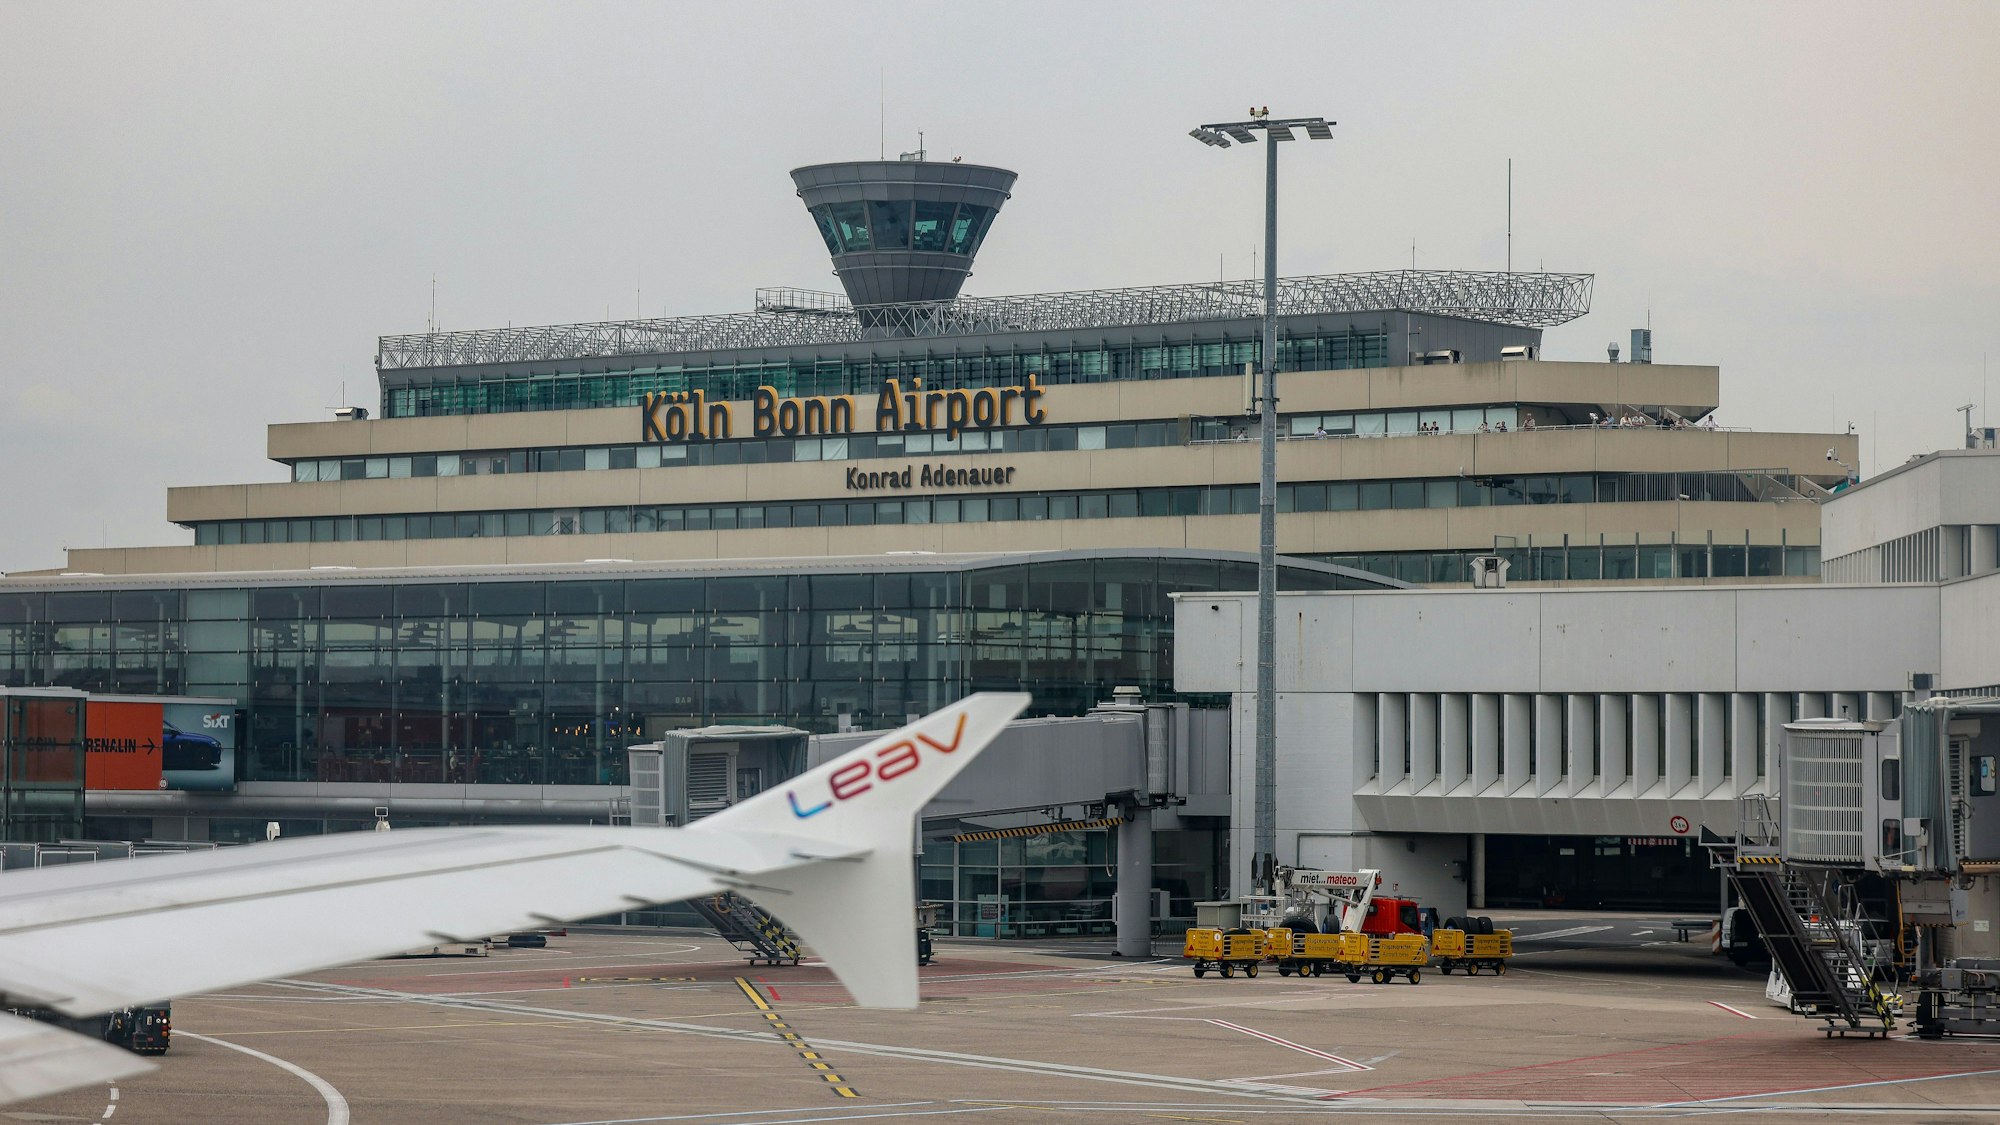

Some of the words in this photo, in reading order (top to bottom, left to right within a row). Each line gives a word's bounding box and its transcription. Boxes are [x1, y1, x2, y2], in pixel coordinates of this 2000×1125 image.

[642, 389, 732, 441] Köln
[754, 386, 855, 437] Bonn
[876, 374, 1048, 441] Airport
[846, 464, 913, 490] Konrad
[920, 463, 1016, 488] Adenauer
